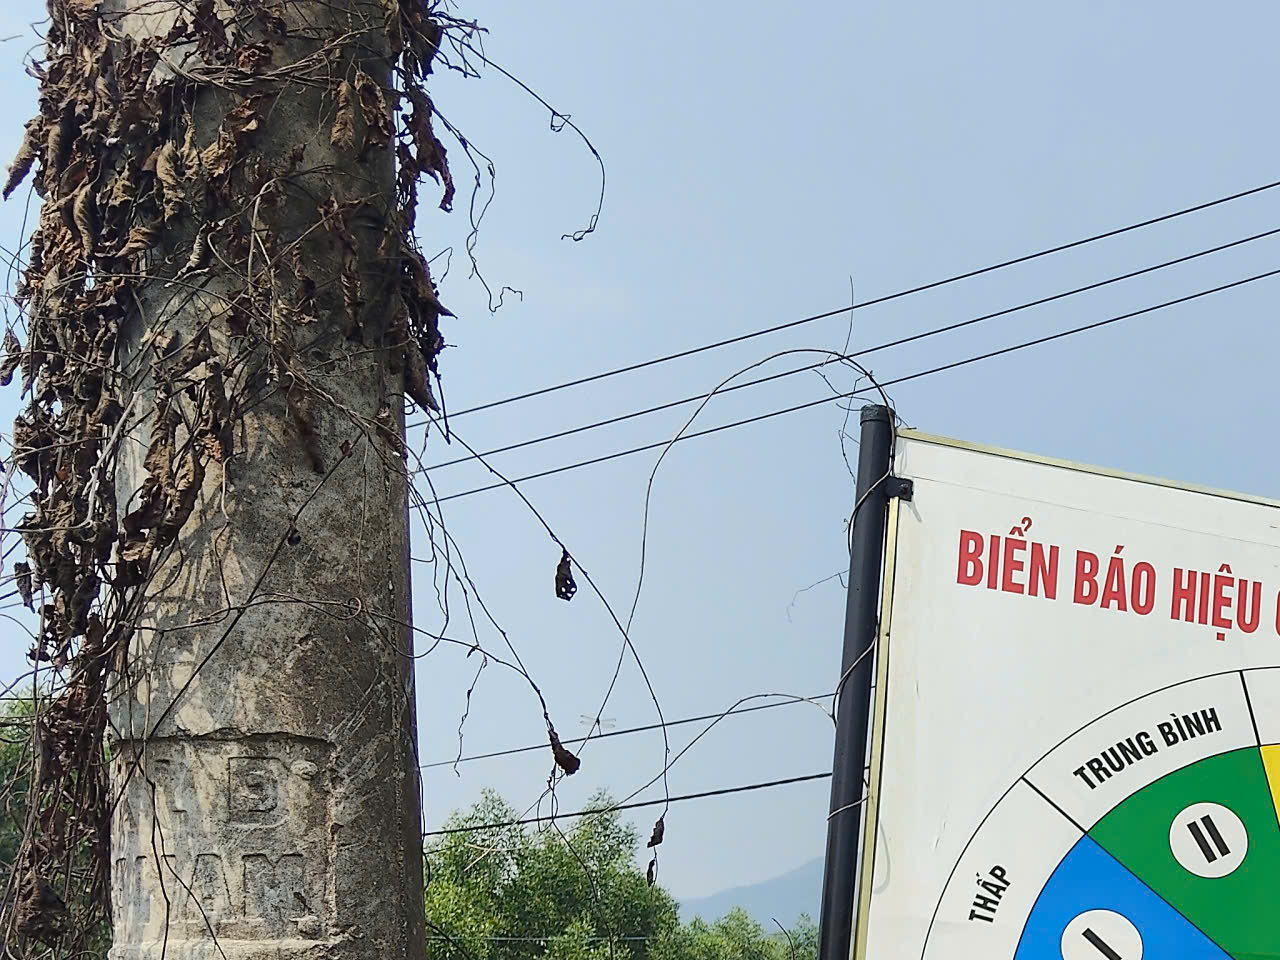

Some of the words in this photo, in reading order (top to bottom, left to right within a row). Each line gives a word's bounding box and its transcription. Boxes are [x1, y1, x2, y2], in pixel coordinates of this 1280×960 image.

[957, 517, 1060, 600] BIỂN
[1073, 545, 1156, 615] BÁO
[1171, 564, 1262, 641] HIỆU
[1073, 731, 1157, 790] TRUNG
[1157, 707, 1222, 748] BÌNH
[1186, 814, 1231, 864] II
[968, 865, 1012, 924] THẤP
